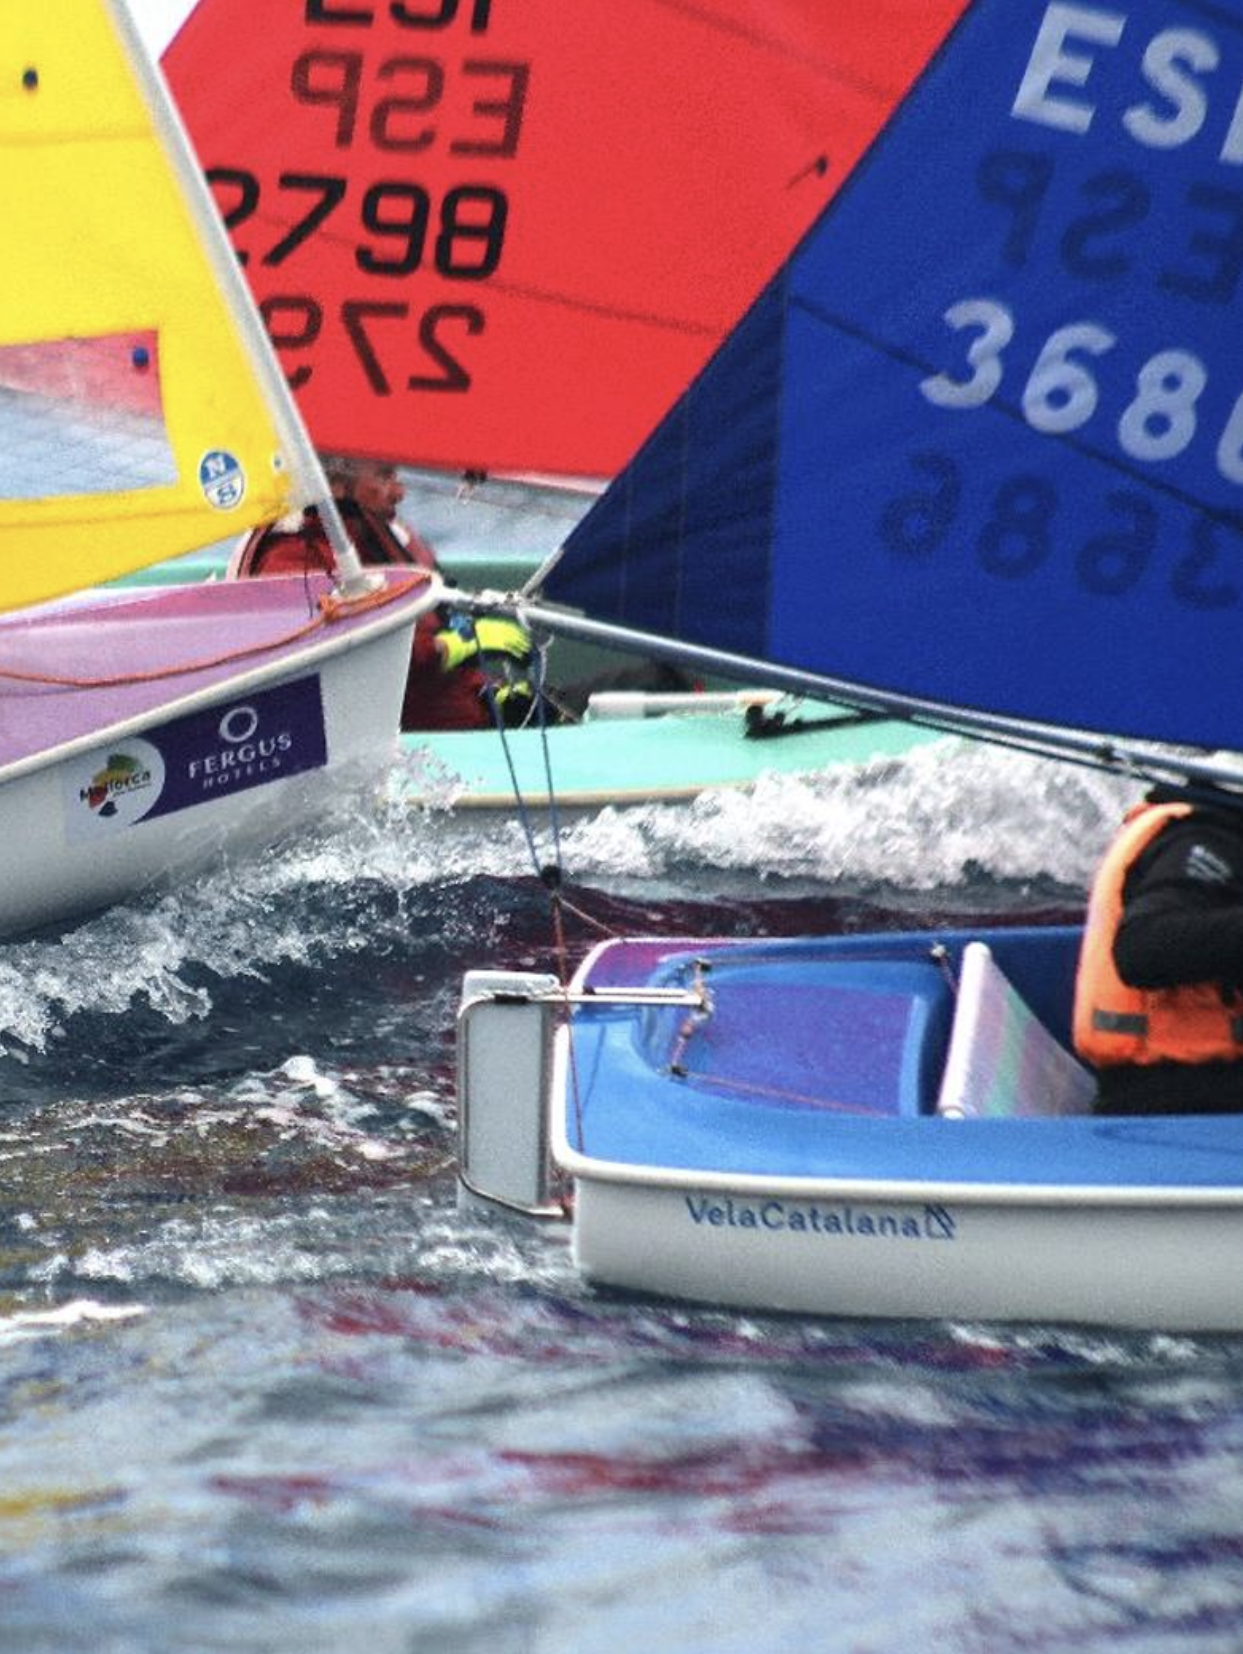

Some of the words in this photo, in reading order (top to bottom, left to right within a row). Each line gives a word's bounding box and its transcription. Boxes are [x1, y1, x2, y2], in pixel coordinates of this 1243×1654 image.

[1010, 1, 1243, 164] ES
[205, 168, 508, 280] 2798
[188, 733, 292, 779] FERGUS
[203, 757, 280, 789] HOTELS
